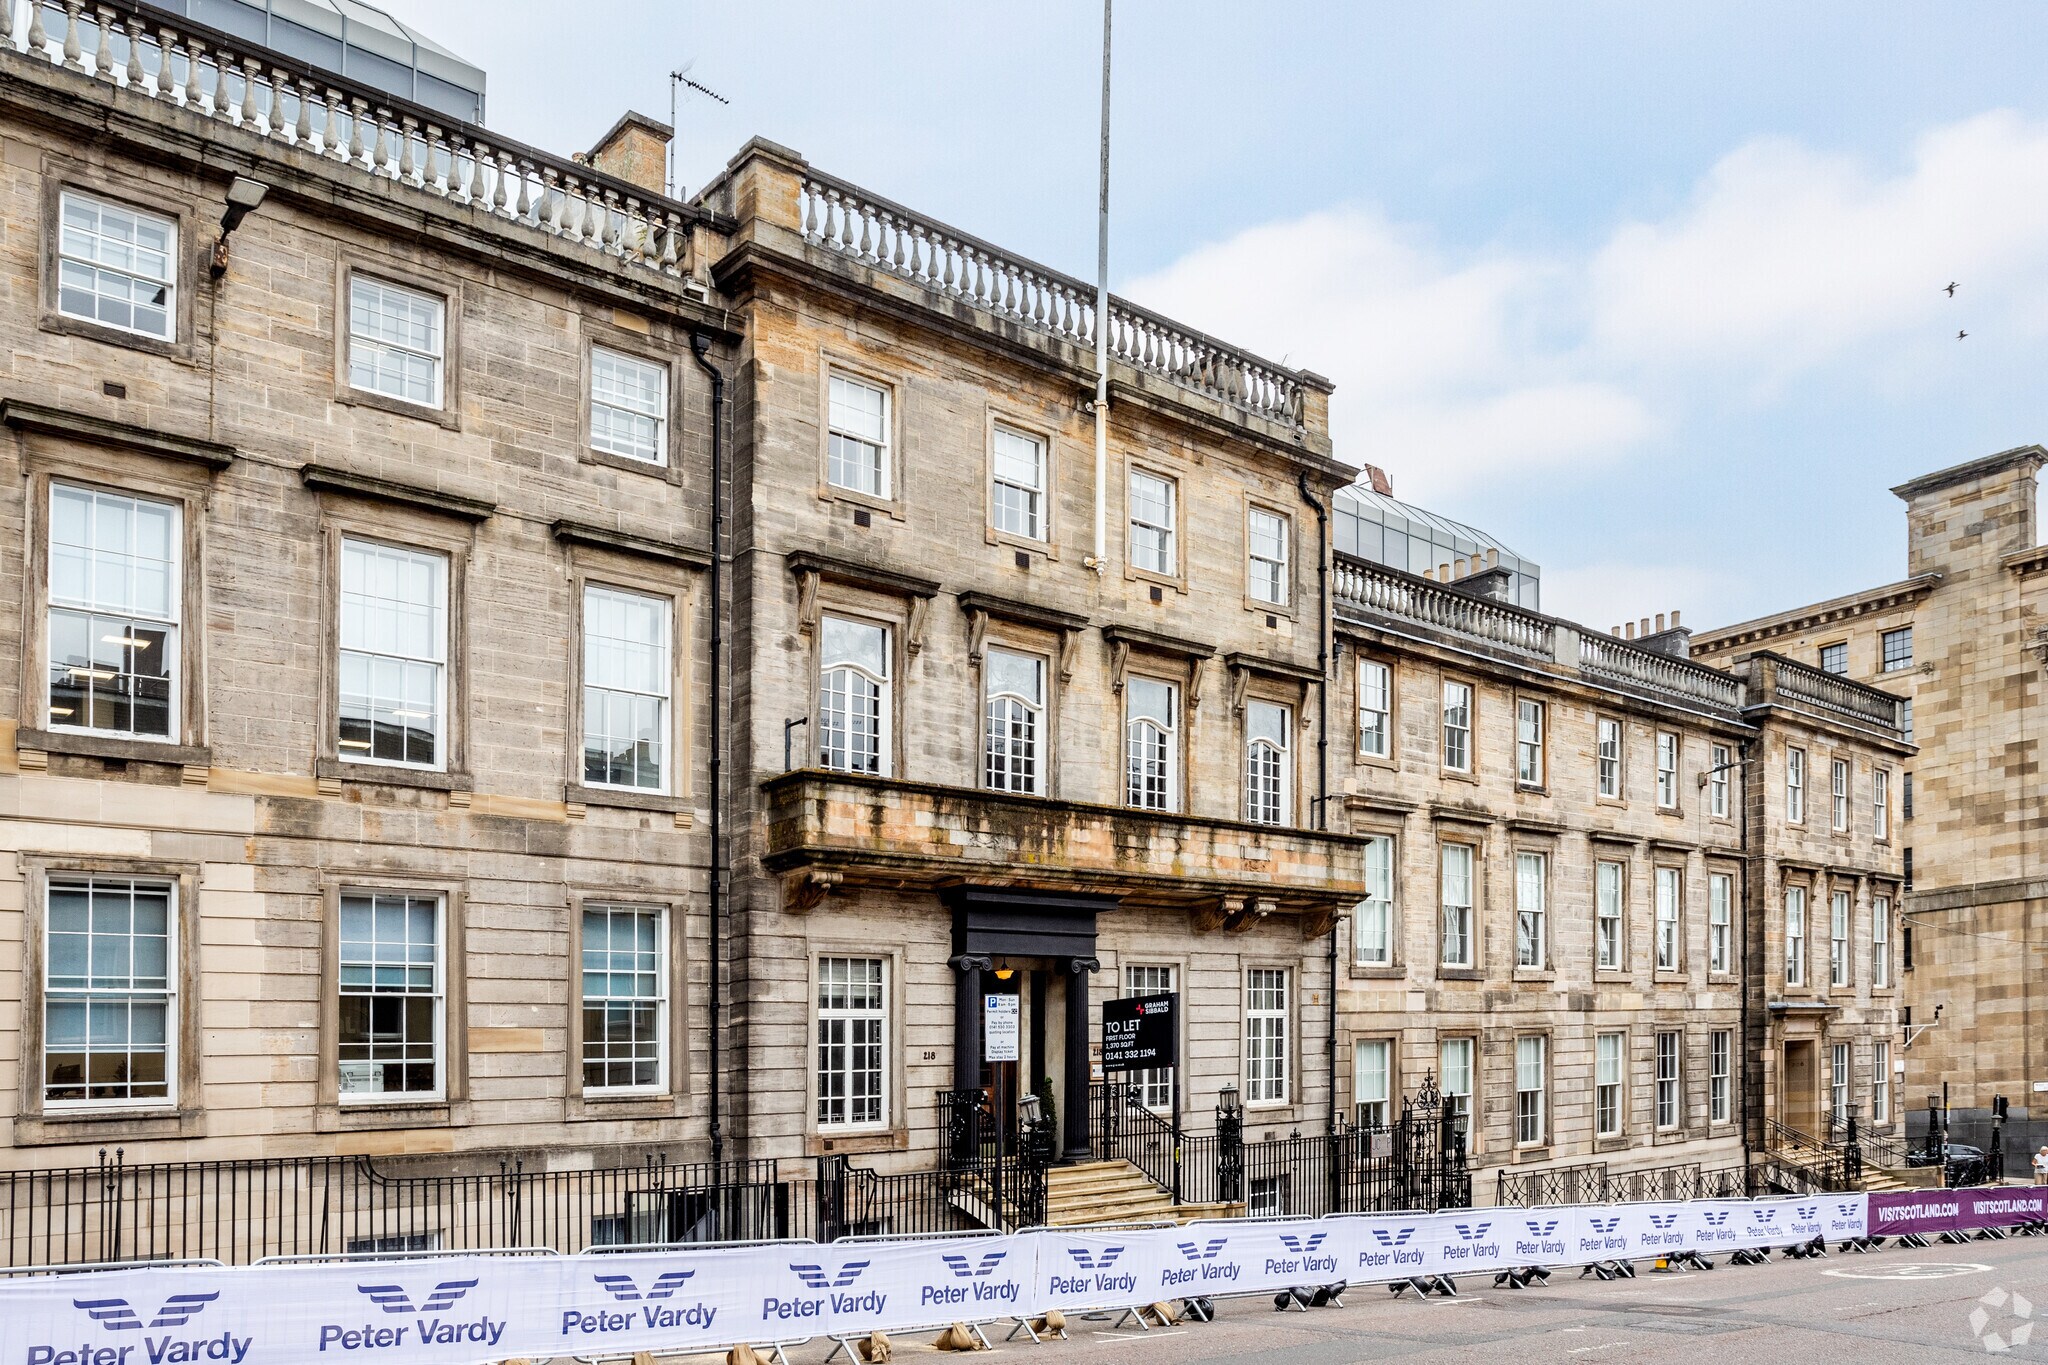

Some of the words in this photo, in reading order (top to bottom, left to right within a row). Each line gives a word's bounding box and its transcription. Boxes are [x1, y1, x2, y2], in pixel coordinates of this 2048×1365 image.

[1145, 1001, 1169, 1009] GRAHAM
[1106, 1021, 1120, 1033] TO
[1123, 1019, 1141, 1032] LET
[923, 1051, 936, 1060] 218
[1105, 1052, 1123, 1060] 0141
[1124, 1050, 1139, 1059] 332
[1140, 1048, 1156, 1058] 1194
[1878, 1202, 1959, 1222] VISITSCOTLAND.COM
[1973, 1199, 2043, 1215] VISITSCOTLAND.COM
[1791, 1223, 1806, 1234] Peter
[1807, 1222, 1822, 1234] Vardy
[1831, 1220, 1846, 1230] Peter
[1847, 1218, 1863, 1230] Vardy
[1641, 1233, 1661, 1245] Peter
[1663, 1231, 1684, 1246] Vardy
[1696, 1229, 1714, 1241] Peter
[1716, 1227, 1736, 1241] Vardy
[1516, 1241, 1540, 1254] Peter
[1542, 1239, 1566, 1255] Vardy
[1581, 1238, 1602, 1250] Peter
[1604, 1235, 1627, 1250] Vardy
[1360, 1252, 1390, 1267] Peter
[1393, 1249, 1424, 1265] Vardy
[1444, 1246, 1470, 1259] Peter
[1473, 1243, 1499, 1258] Vardy
[1265, 1259, 1299, 1274] Peter
[1303, 1255, 1337, 1272] Vardy
[1162, 1269, 1197, 1286] Peter
[1202, 1262, 1240, 1280] Vardy
[1050, 1277, 1091, 1294] Peter
[1096, 1273, 1136, 1293] Vardy
[922, 1286, 968, 1305] Peter
[973, 1280, 1019, 1302] Vardy
[763, 1298, 824, 1320] Peter
[831, 1291, 887, 1314] Vardy
[563, 1311, 636, 1335] Peter
[643, 1303, 717, 1329] Vardy
[320, 1325, 408, 1351] Peter
[417, 1316, 506, 1346] Vardy
[28, 1344, 134, 1365] Peter
[145, 1332, 252, 1364] Vardy
